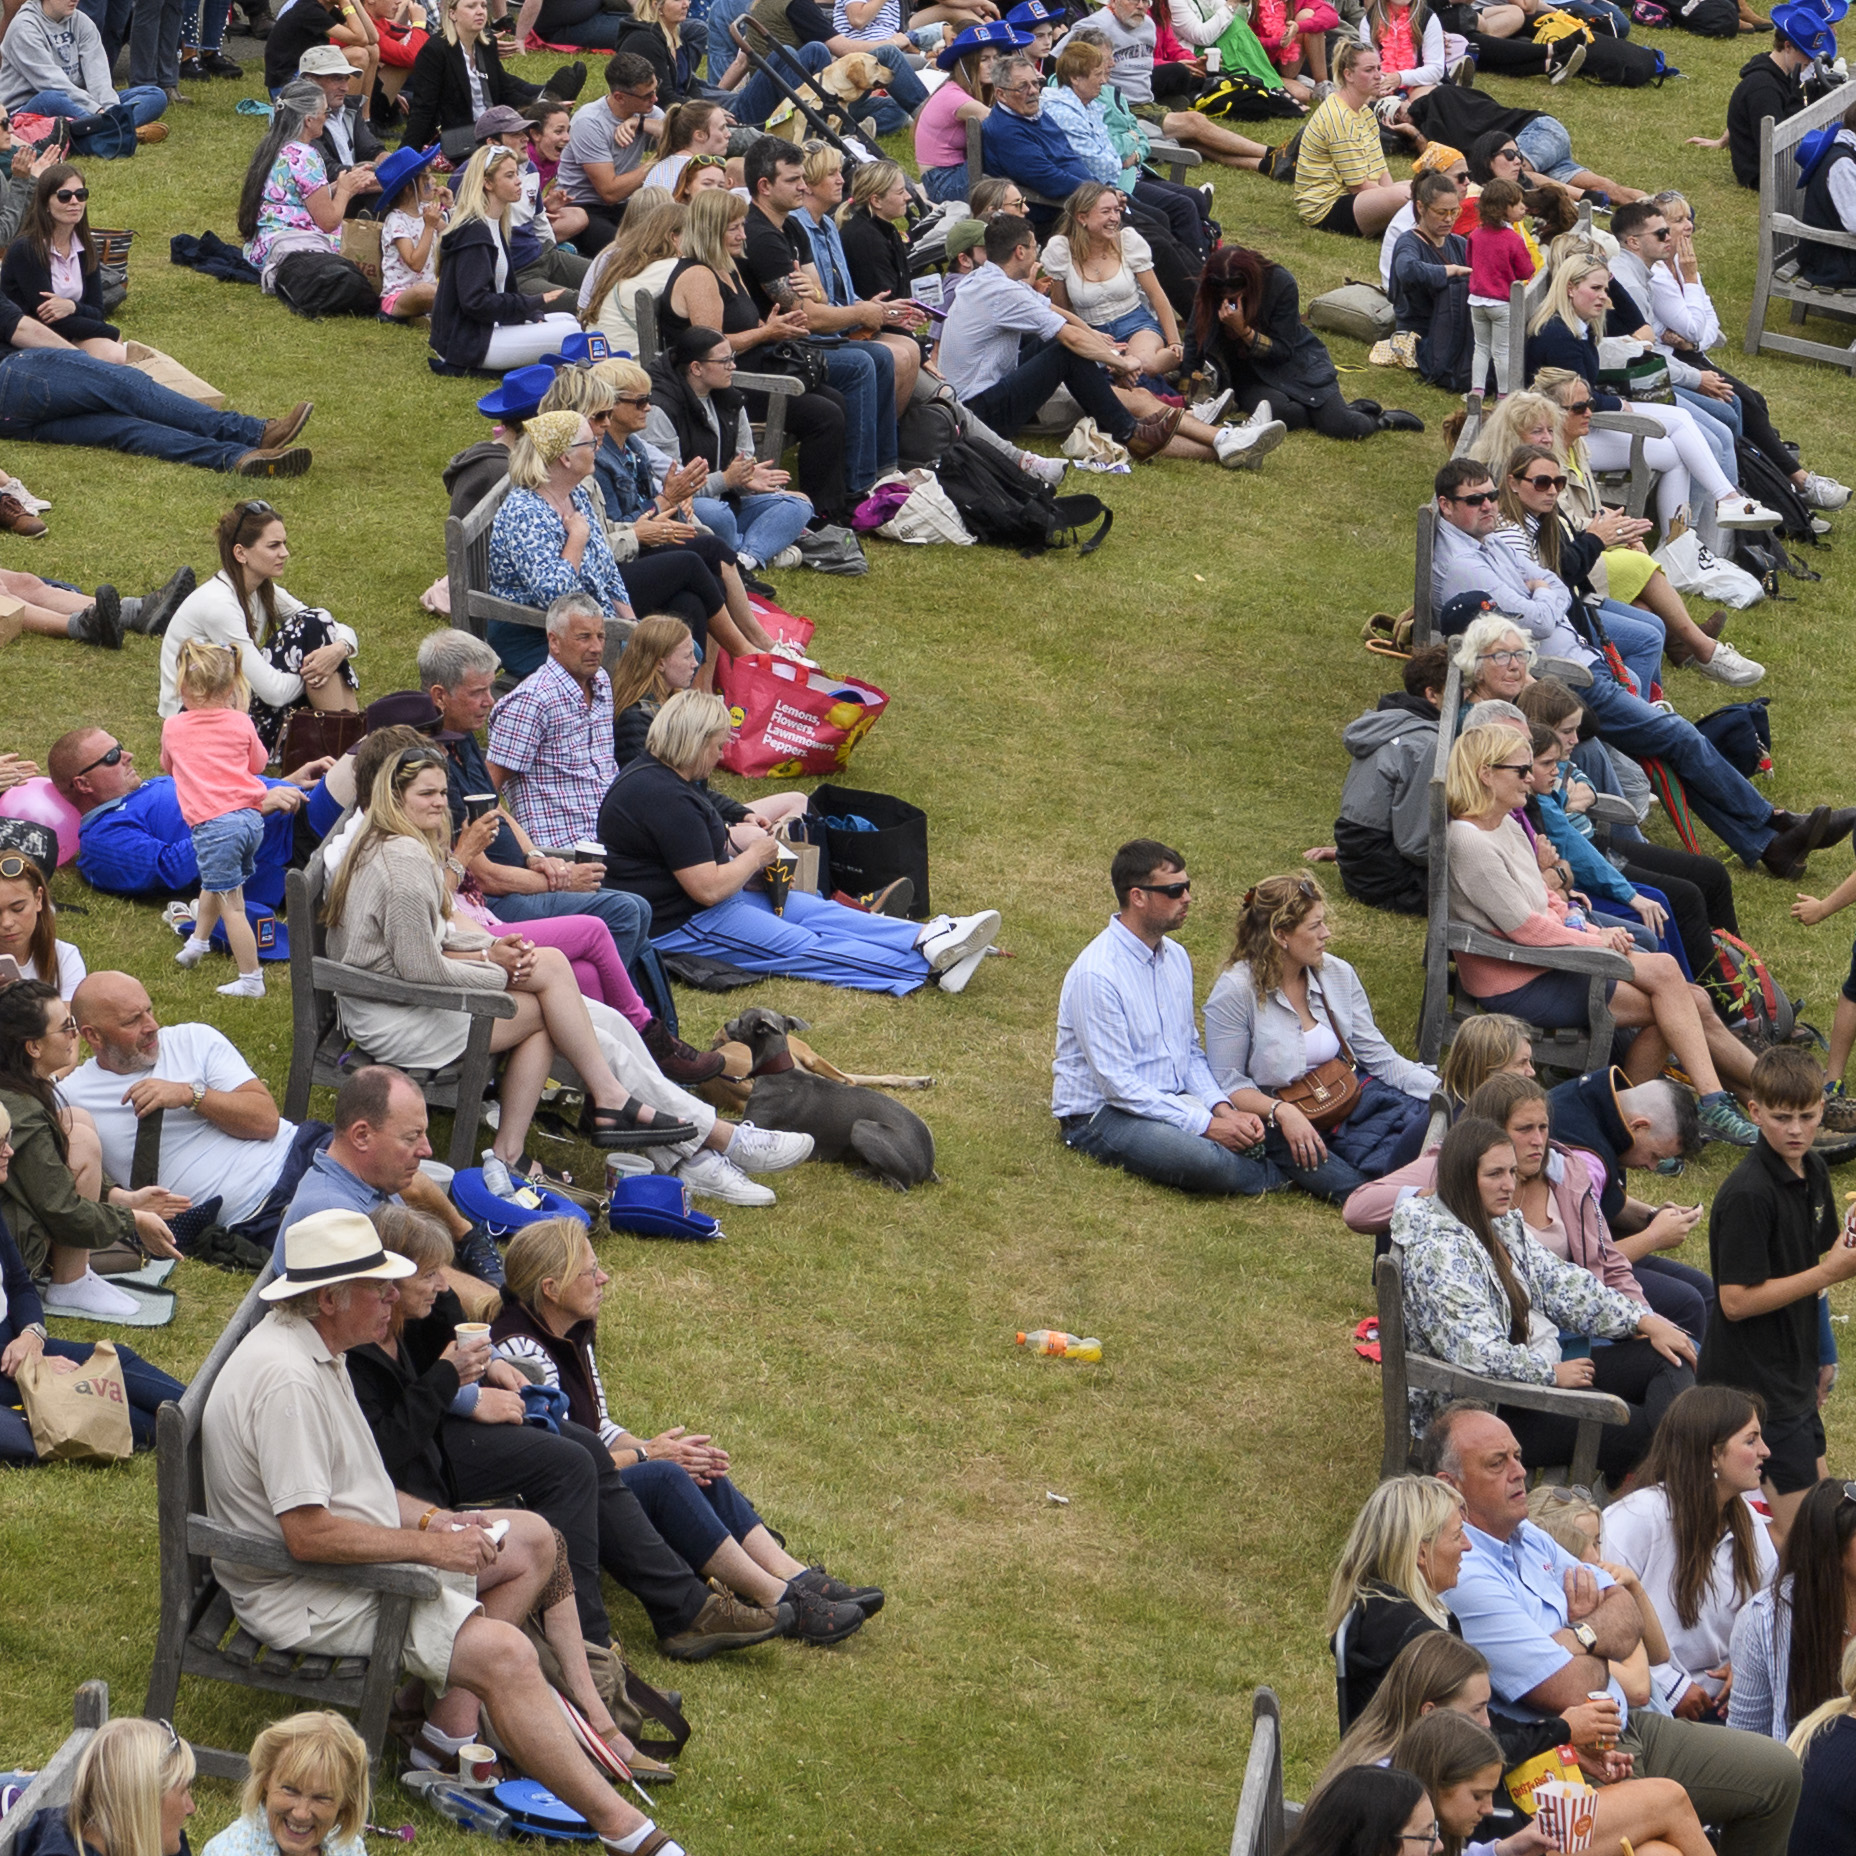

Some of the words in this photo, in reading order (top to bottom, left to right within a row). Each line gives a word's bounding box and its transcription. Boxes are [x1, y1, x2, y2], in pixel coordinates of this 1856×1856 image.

[770, 709, 816, 738] Flowers,
[775, 698, 821, 727] Lemons,
[761, 732, 809, 758] Peppers.
[766, 721, 837, 753] Lawnmowers,
